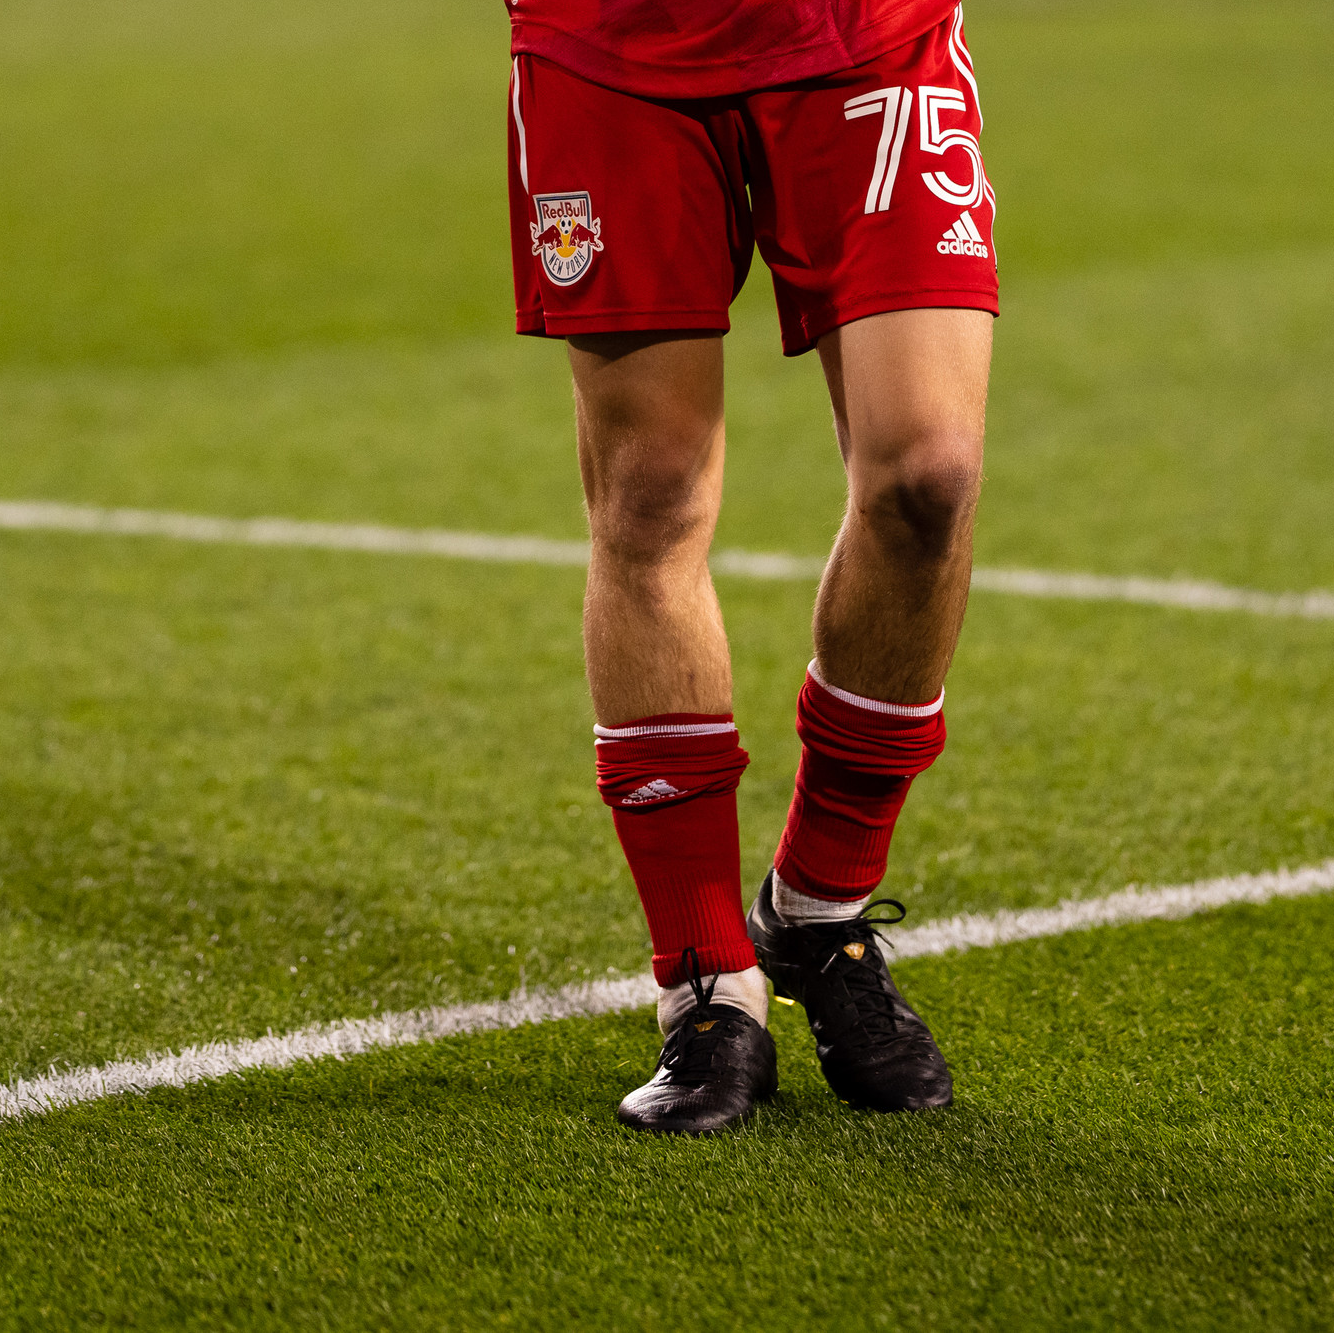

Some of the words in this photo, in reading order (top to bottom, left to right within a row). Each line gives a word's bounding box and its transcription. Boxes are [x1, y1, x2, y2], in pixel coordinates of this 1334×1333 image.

[843, 85, 984, 215] 75
[936, 236, 989, 259] adidas
[548, 252, 564, 276] NEW
[566, 250, 586, 276] YORK
